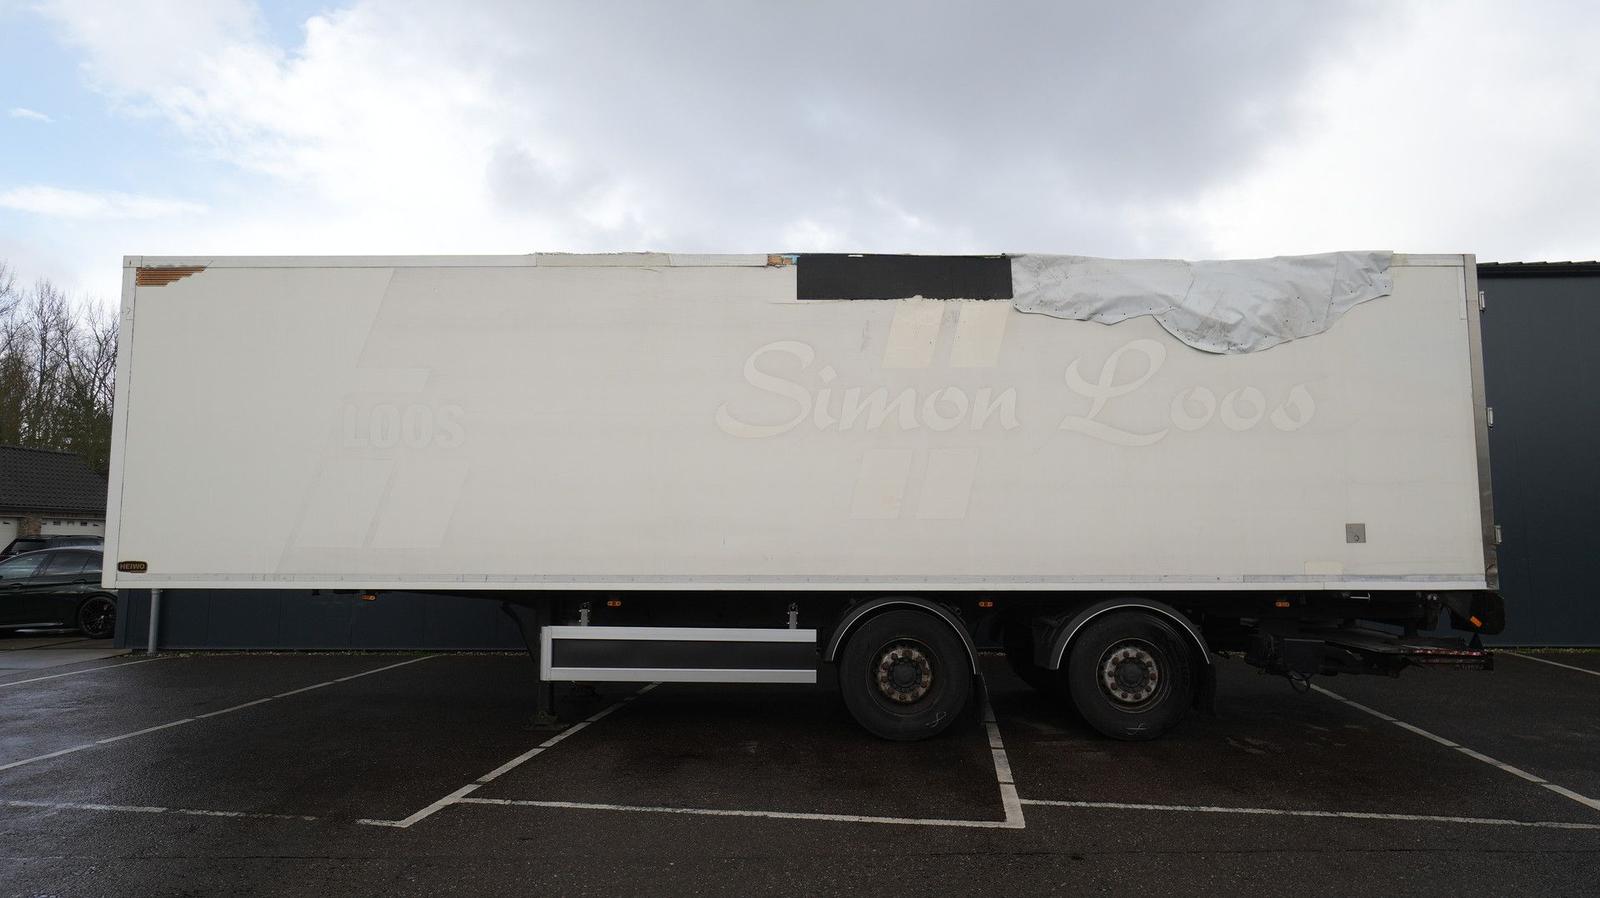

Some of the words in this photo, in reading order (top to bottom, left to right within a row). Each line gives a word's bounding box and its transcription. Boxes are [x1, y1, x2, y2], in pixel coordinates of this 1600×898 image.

[342, 403, 466, 449] LOOS
[715, 340, 1020, 438] Simon
[1058, 339, 1316, 446] Loos
